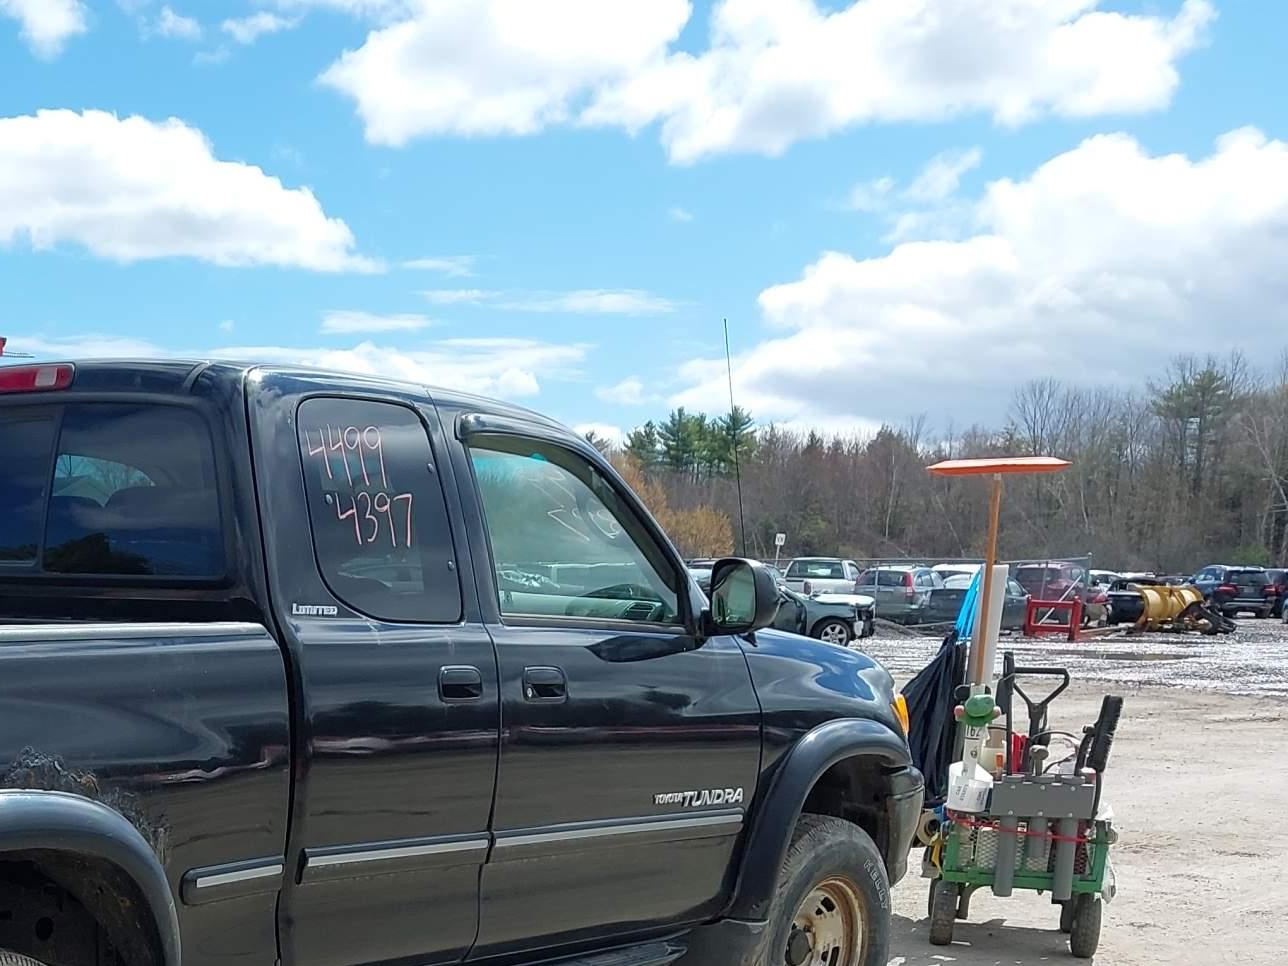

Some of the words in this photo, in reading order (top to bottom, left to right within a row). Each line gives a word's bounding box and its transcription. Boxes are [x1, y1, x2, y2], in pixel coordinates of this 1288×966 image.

[305, 423, 387, 488] 4499
[335, 491, 412, 548] 4397
[655, 792, 683, 805] TOYOTA
[682, 787, 744, 808] TUNDRA
[864, 859, 889, 909] KELLY
